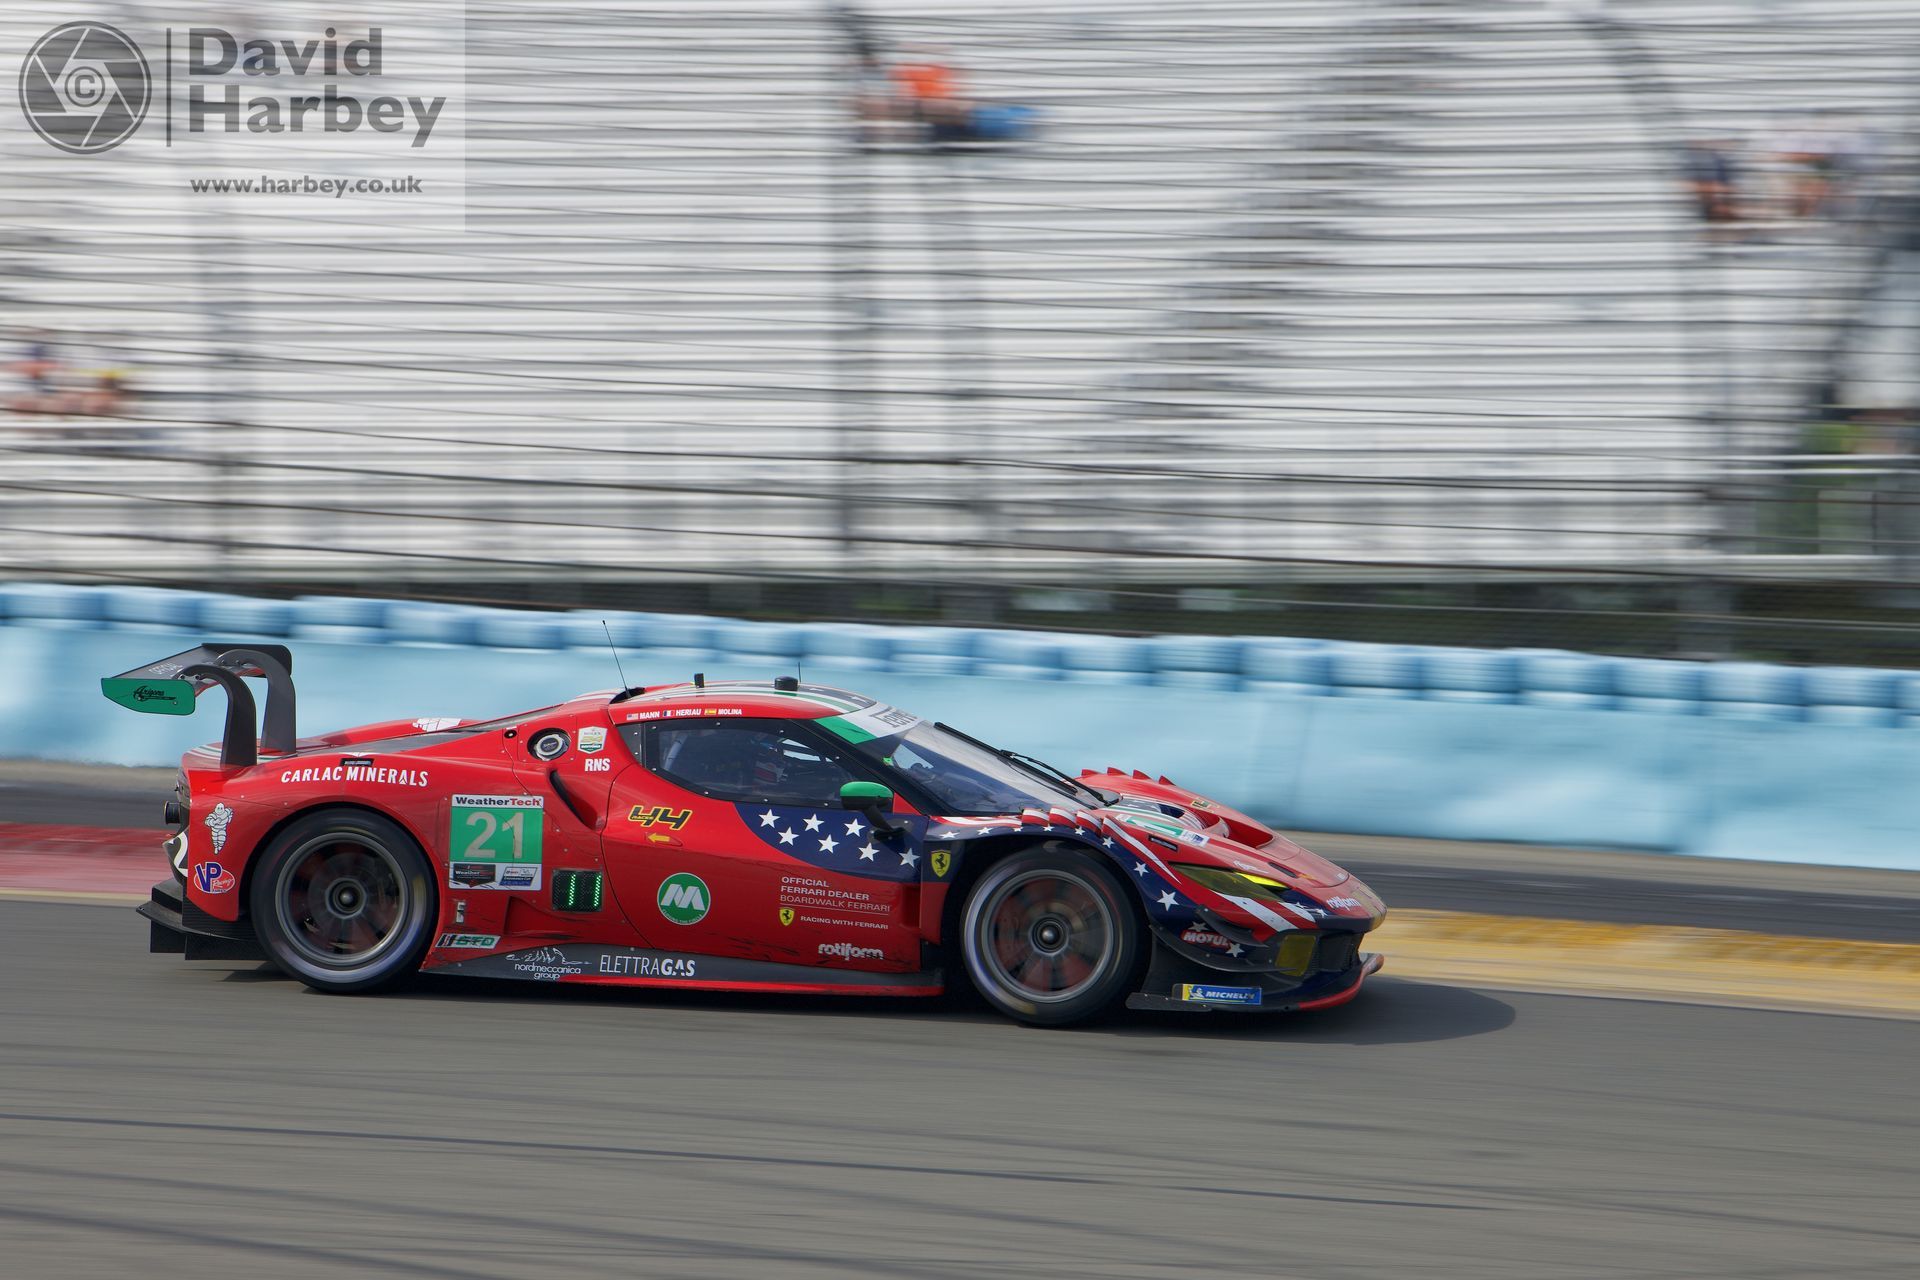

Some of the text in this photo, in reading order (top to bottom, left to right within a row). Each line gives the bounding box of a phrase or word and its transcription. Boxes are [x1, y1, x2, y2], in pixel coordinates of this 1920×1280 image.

[640, 711, 660, 719] MANN
[676, 708, 702, 716] HERIAU
[584, 758, 611, 772] RNS
[281, 766, 429, 787] CARLAC MINERALS
[456, 796, 540, 806] WeatherTech
[628, 805, 693, 831] 44
[464, 811, 524, 859] 21
[194, 861, 223, 893] VP
[781, 876, 829, 888] OFFICIAL
[780, 885, 870, 901] FERRARI DEALER
[780, 894, 891, 912] BOARDWALK FERRARI
[800, 915, 831, 924] RACING
[855, 921, 889, 930] FERRARI
[1183, 931, 1230, 948] MOTUL
[818, 943, 884, 960] rotiform
[514, 962, 582, 975] nordmeccanica
[600, 954, 696, 977] ELETTRAGAS
[534, 972, 560, 981] group
